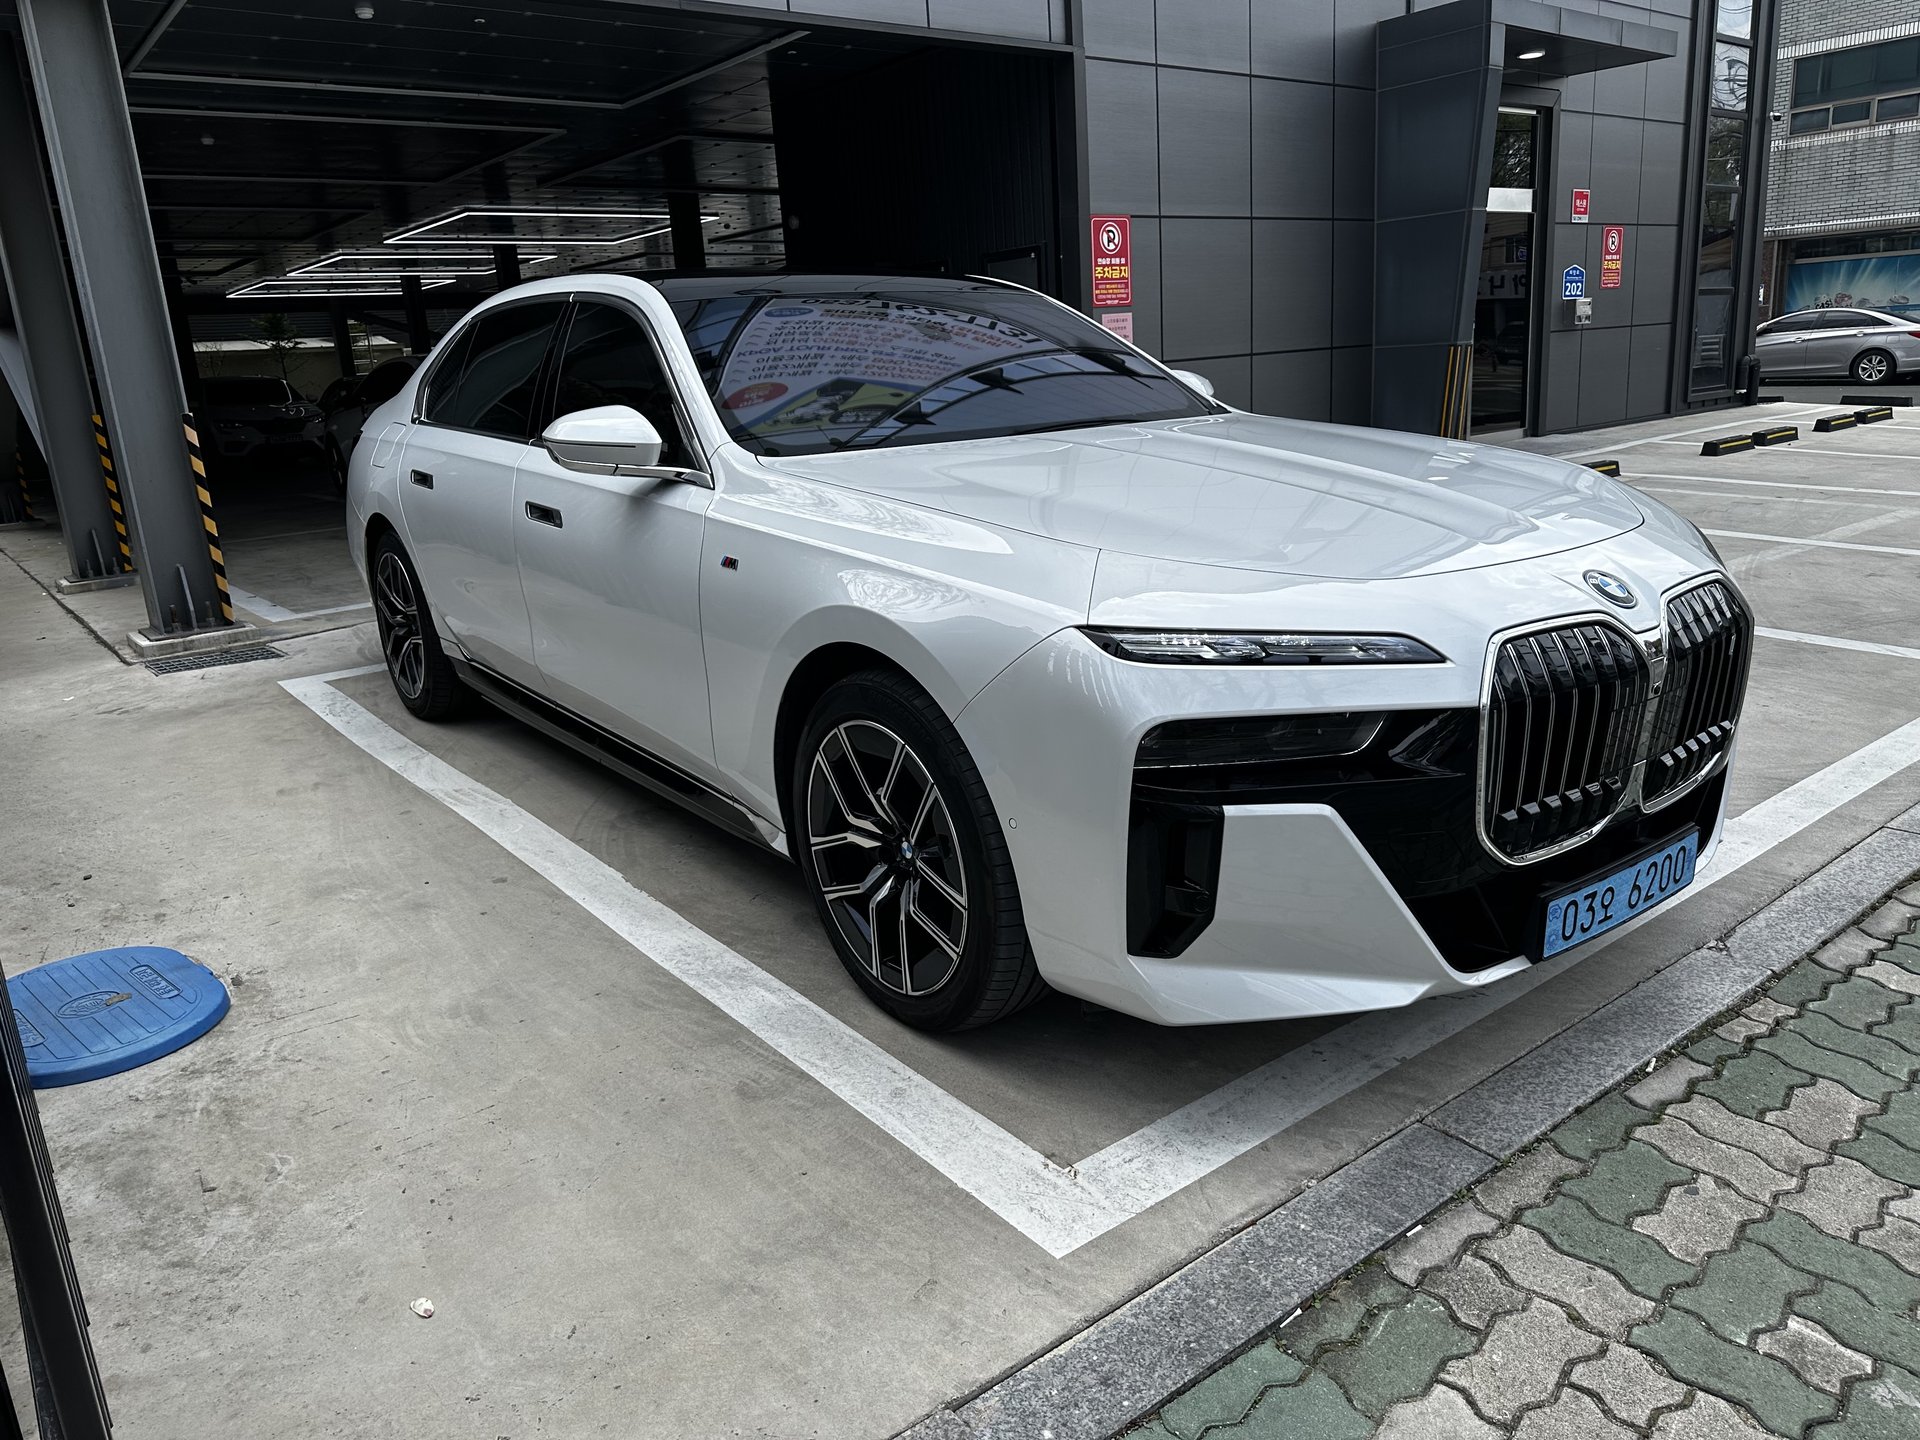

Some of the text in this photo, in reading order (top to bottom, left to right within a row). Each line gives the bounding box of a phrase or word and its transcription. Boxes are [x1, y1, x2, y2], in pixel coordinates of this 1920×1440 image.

[1095, 266, 1129, 279] 주차금지
[1565, 282, 1582, 296] 202
[1561, 885, 1615, 942] 03오
[1627, 845, 1687, 910] 6200
